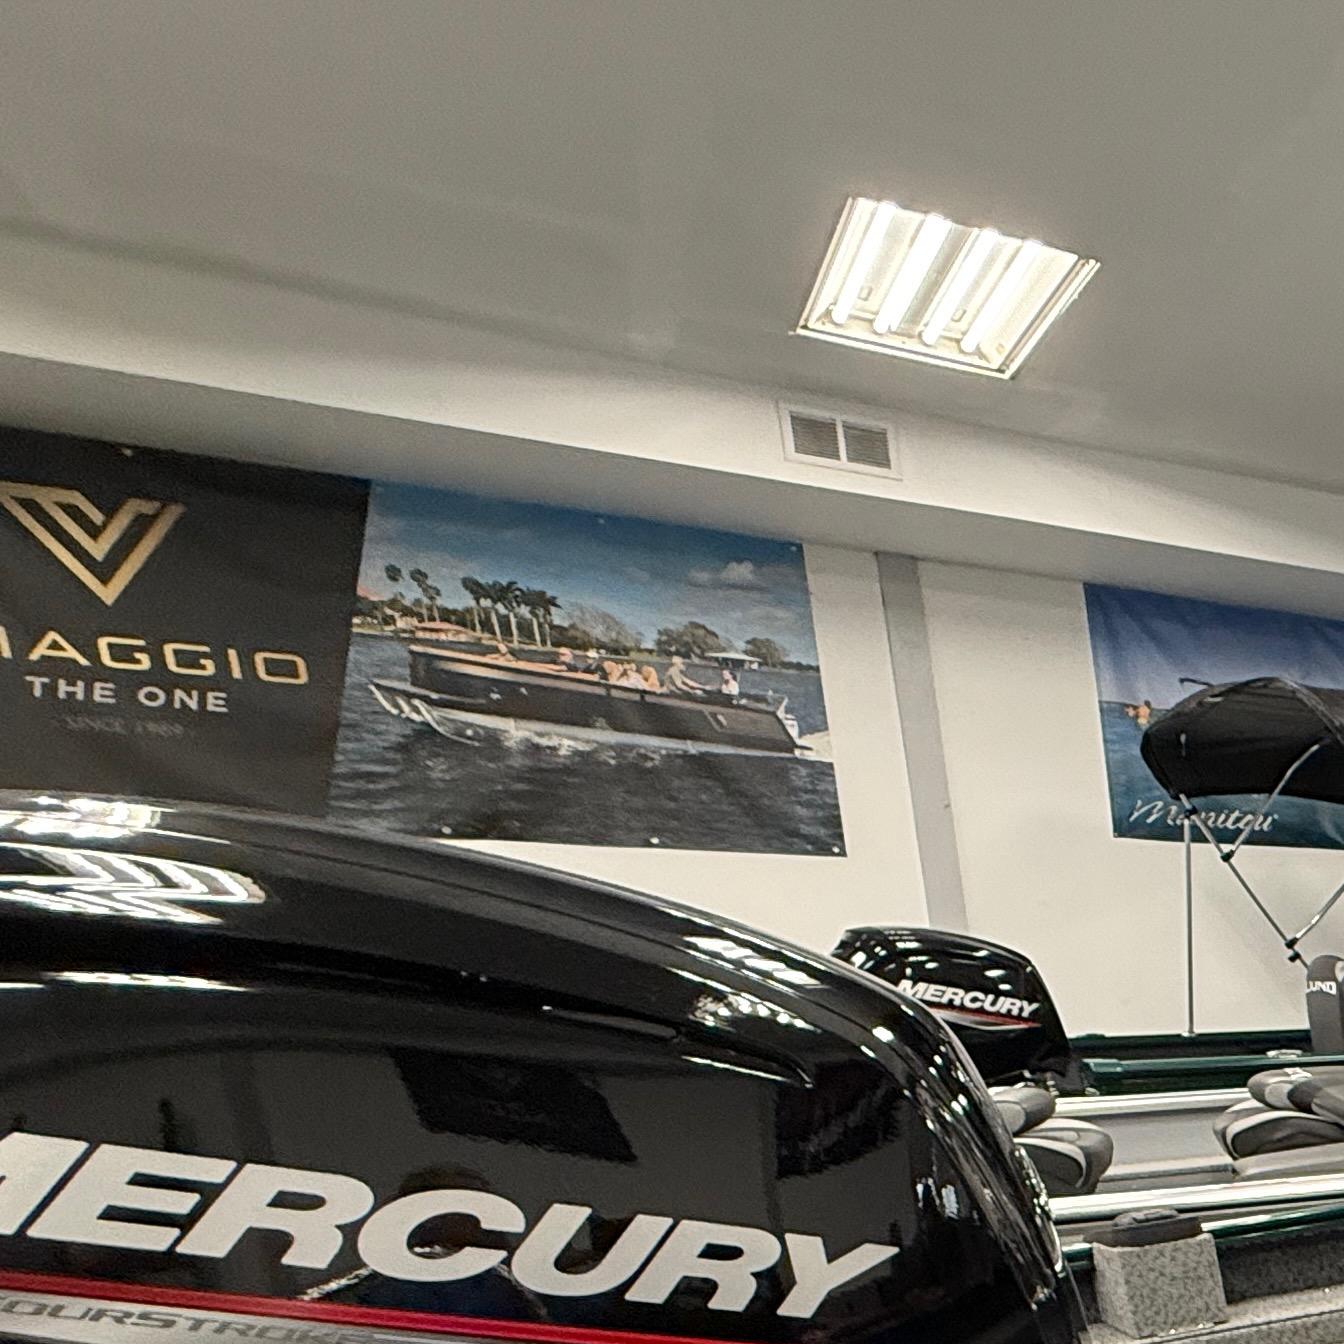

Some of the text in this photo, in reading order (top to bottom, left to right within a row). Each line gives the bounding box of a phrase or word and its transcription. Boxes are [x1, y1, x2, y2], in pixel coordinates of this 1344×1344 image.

[25, 675, 229, 713] THE ONE
[896, 979, 1041, 1018] MERCURY
